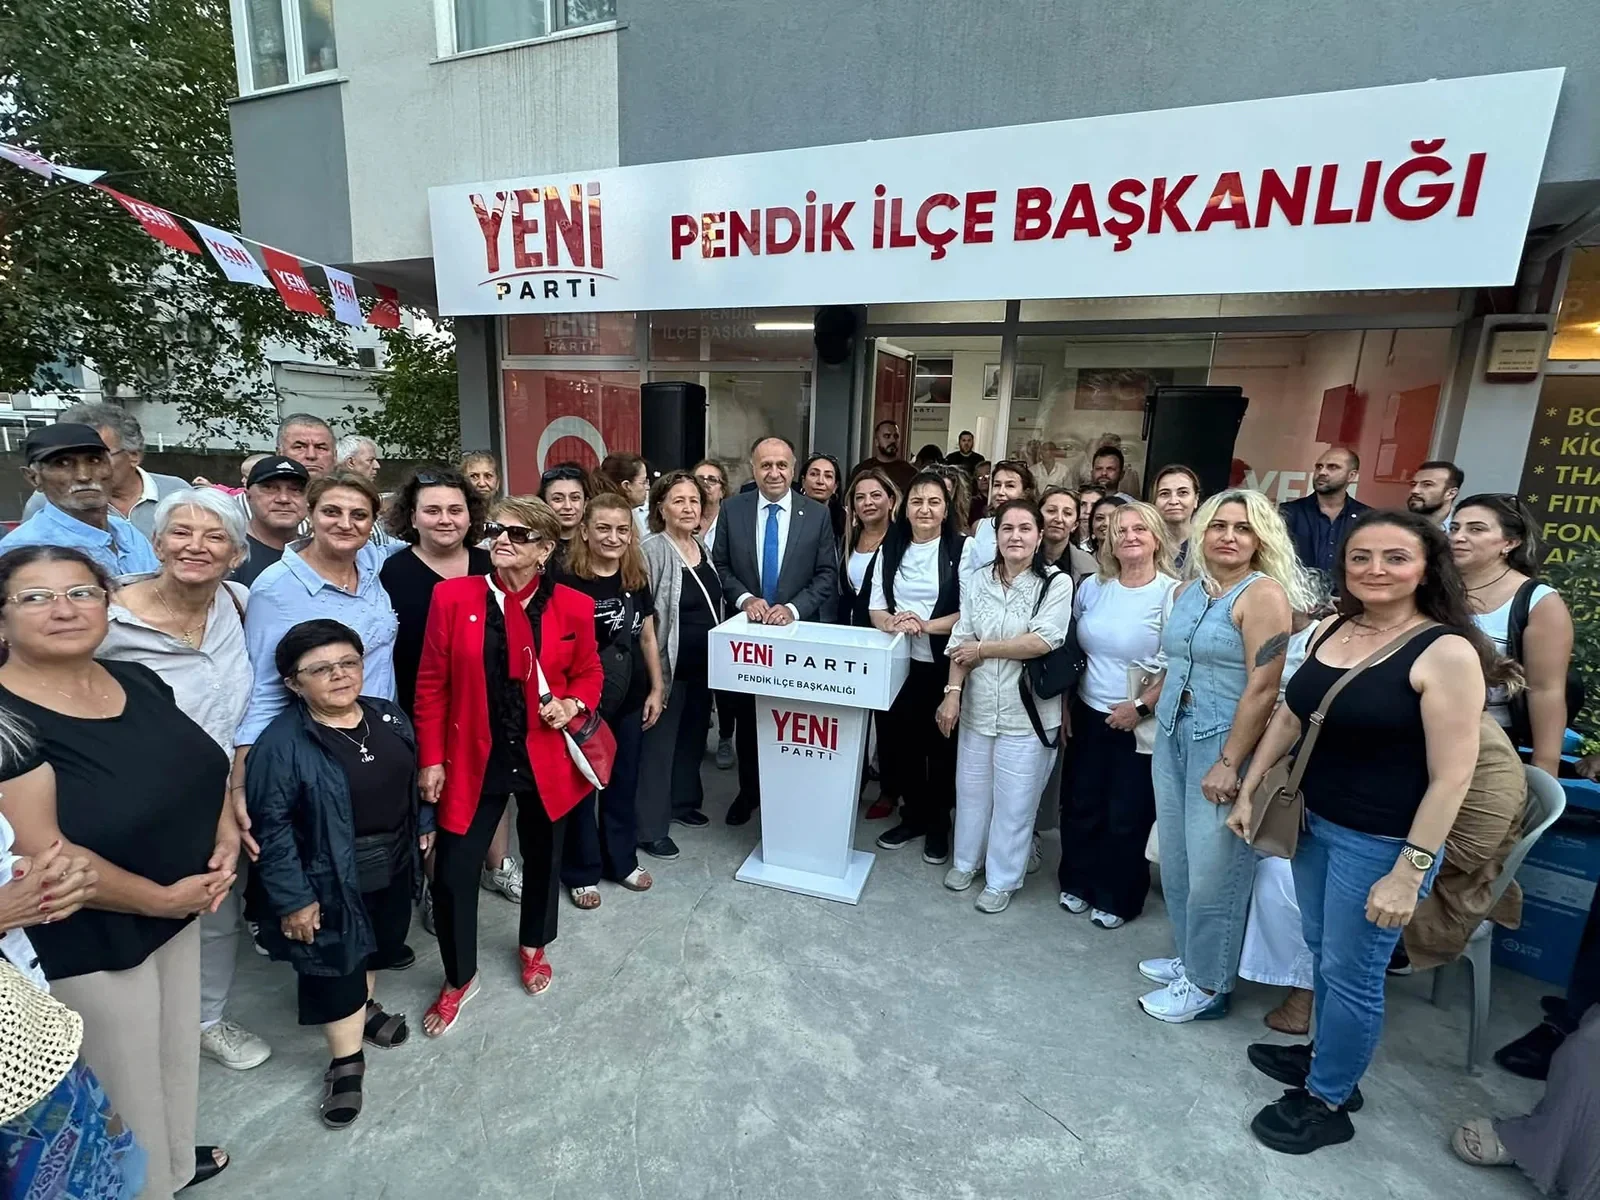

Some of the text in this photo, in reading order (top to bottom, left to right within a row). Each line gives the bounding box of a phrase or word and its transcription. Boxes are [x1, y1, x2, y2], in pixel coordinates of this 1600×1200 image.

[671, 137, 1487, 261] PENDİK İLÇE BAŞKANLIĞI
[737, 673, 856, 695] PENDİK İLÇE BAŞKANLIĞI
